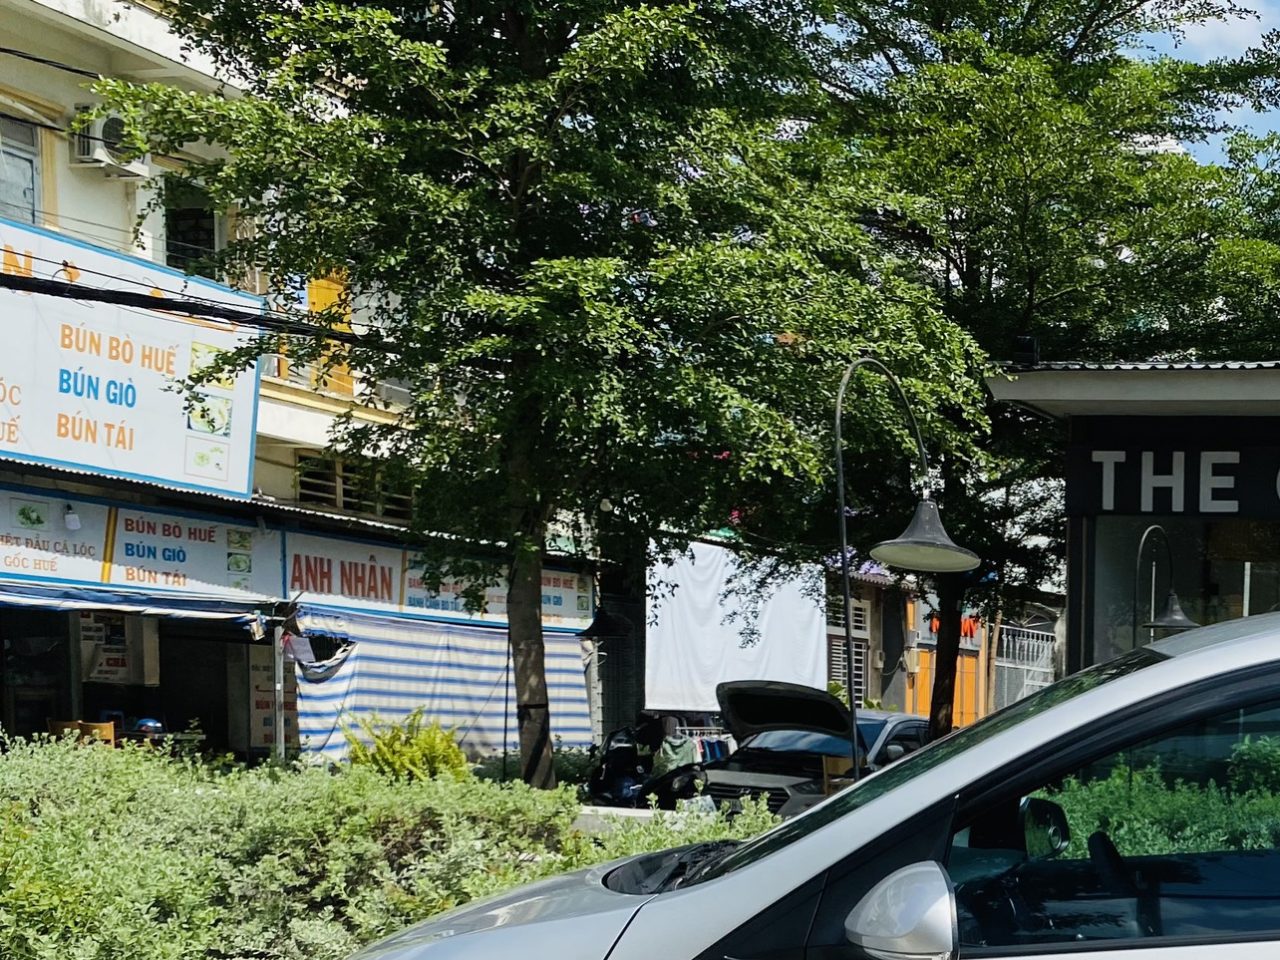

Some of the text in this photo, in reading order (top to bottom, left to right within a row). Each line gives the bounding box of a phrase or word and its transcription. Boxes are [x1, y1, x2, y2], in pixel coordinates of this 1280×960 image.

[60, 323, 180, 376] BÚN BÒ HUẾ
[58, 366, 137, 408] BÚN GIÒ
[56, 410, 134, 451] BÚN TÁI
[1092, 450, 1241, 513] THE
[124, 516, 218, 543] BÚN BÒ HUẾ
[33, 556, 58, 572] HUẾ
[124, 541, 187, 563] BÚN GIÒ
[125, 565, 187, 587] BÚN TÁI
[290, 553, 394, 601] ANH NHÂN
